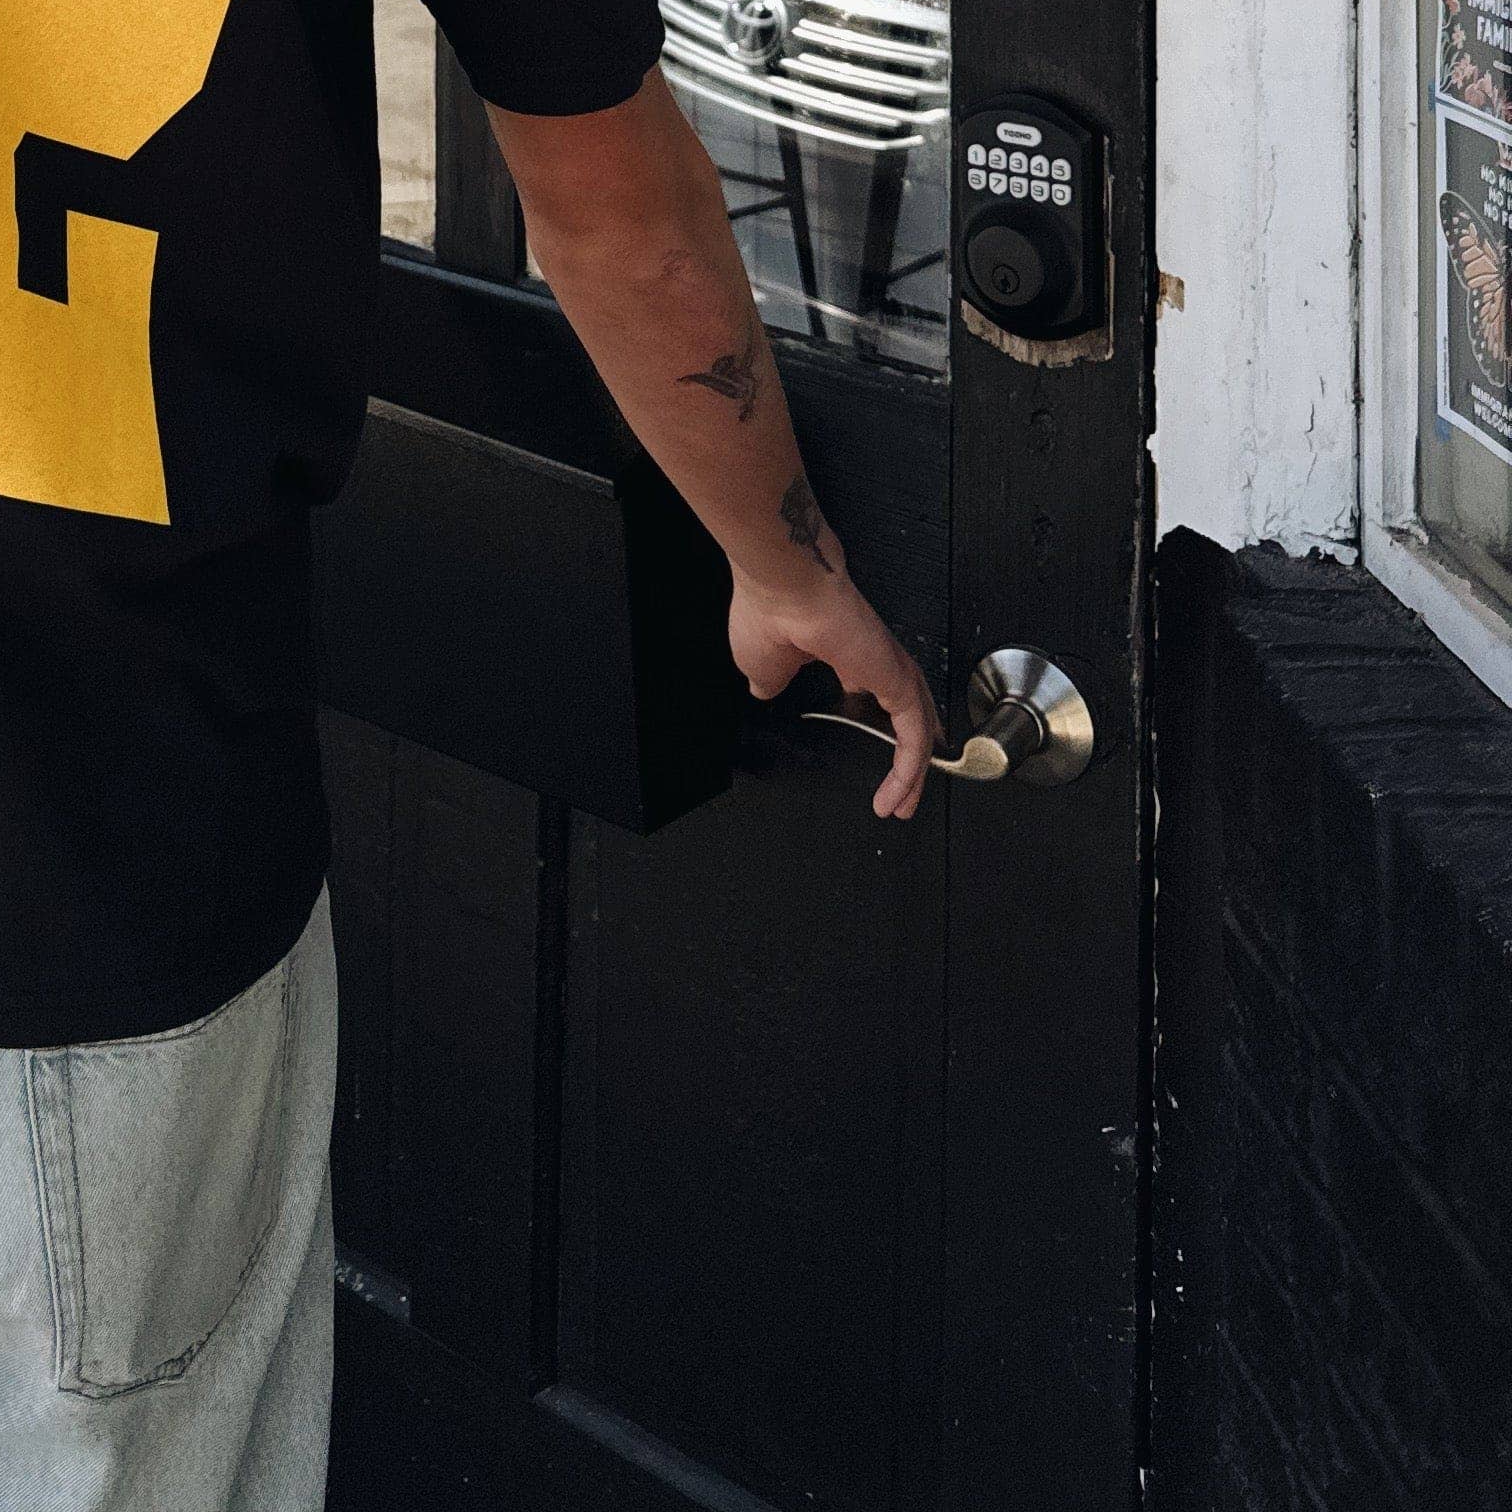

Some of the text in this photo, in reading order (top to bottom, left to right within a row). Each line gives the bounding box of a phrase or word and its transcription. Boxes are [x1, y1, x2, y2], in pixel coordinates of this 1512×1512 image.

[991, 153, 1002, 166] 2
[1011, 157, 1023, 170] 3
[1033, 161, 1044, 173] 4
[1053, 165, 1066, 177] 5
[970, 173, 1066, 201] 6 7 8 9 0
